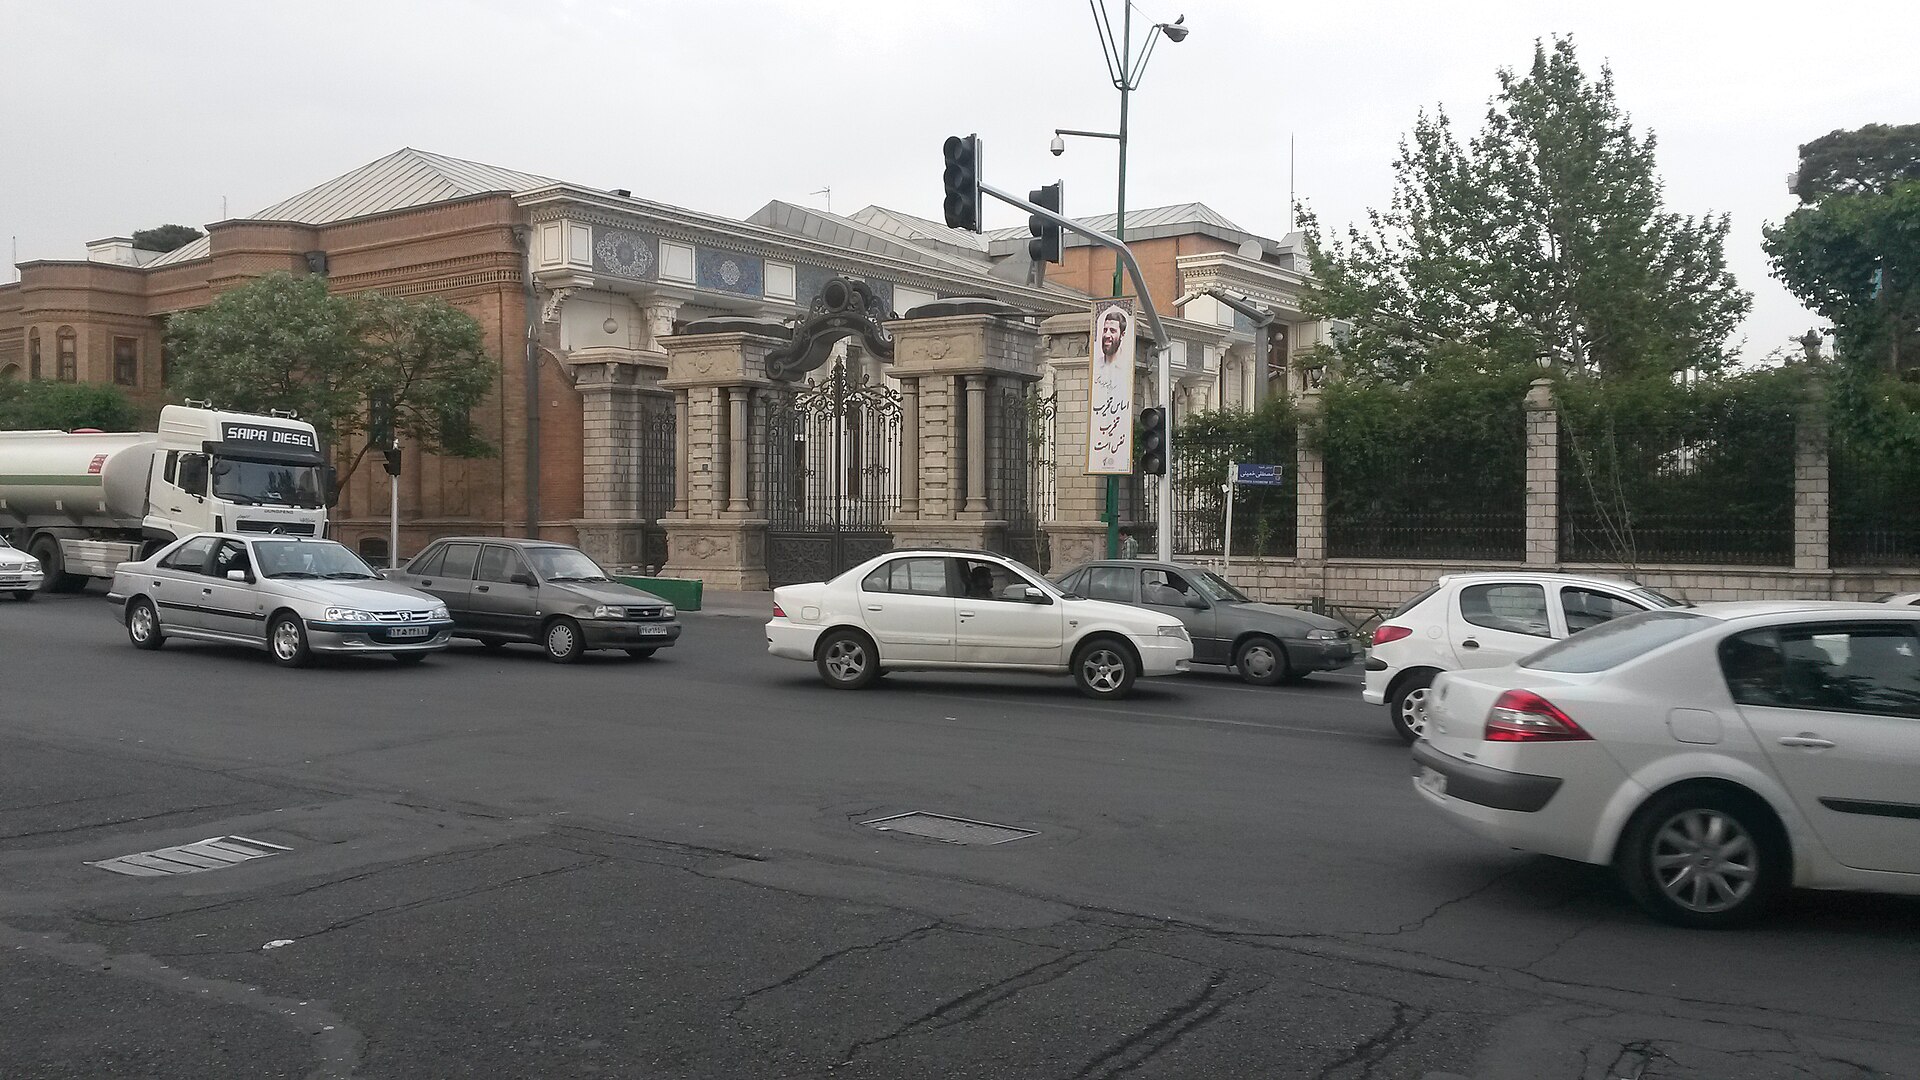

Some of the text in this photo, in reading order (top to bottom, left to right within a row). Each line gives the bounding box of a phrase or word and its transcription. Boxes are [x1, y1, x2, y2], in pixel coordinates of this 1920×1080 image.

[1093, 397, 1129, 416] اساس تخریب
[1100, 416, 1120, 436] تخریب
[227, 427, 313, 447] SAIPA DIESEL
[1094, 441, 1111, 451] است
